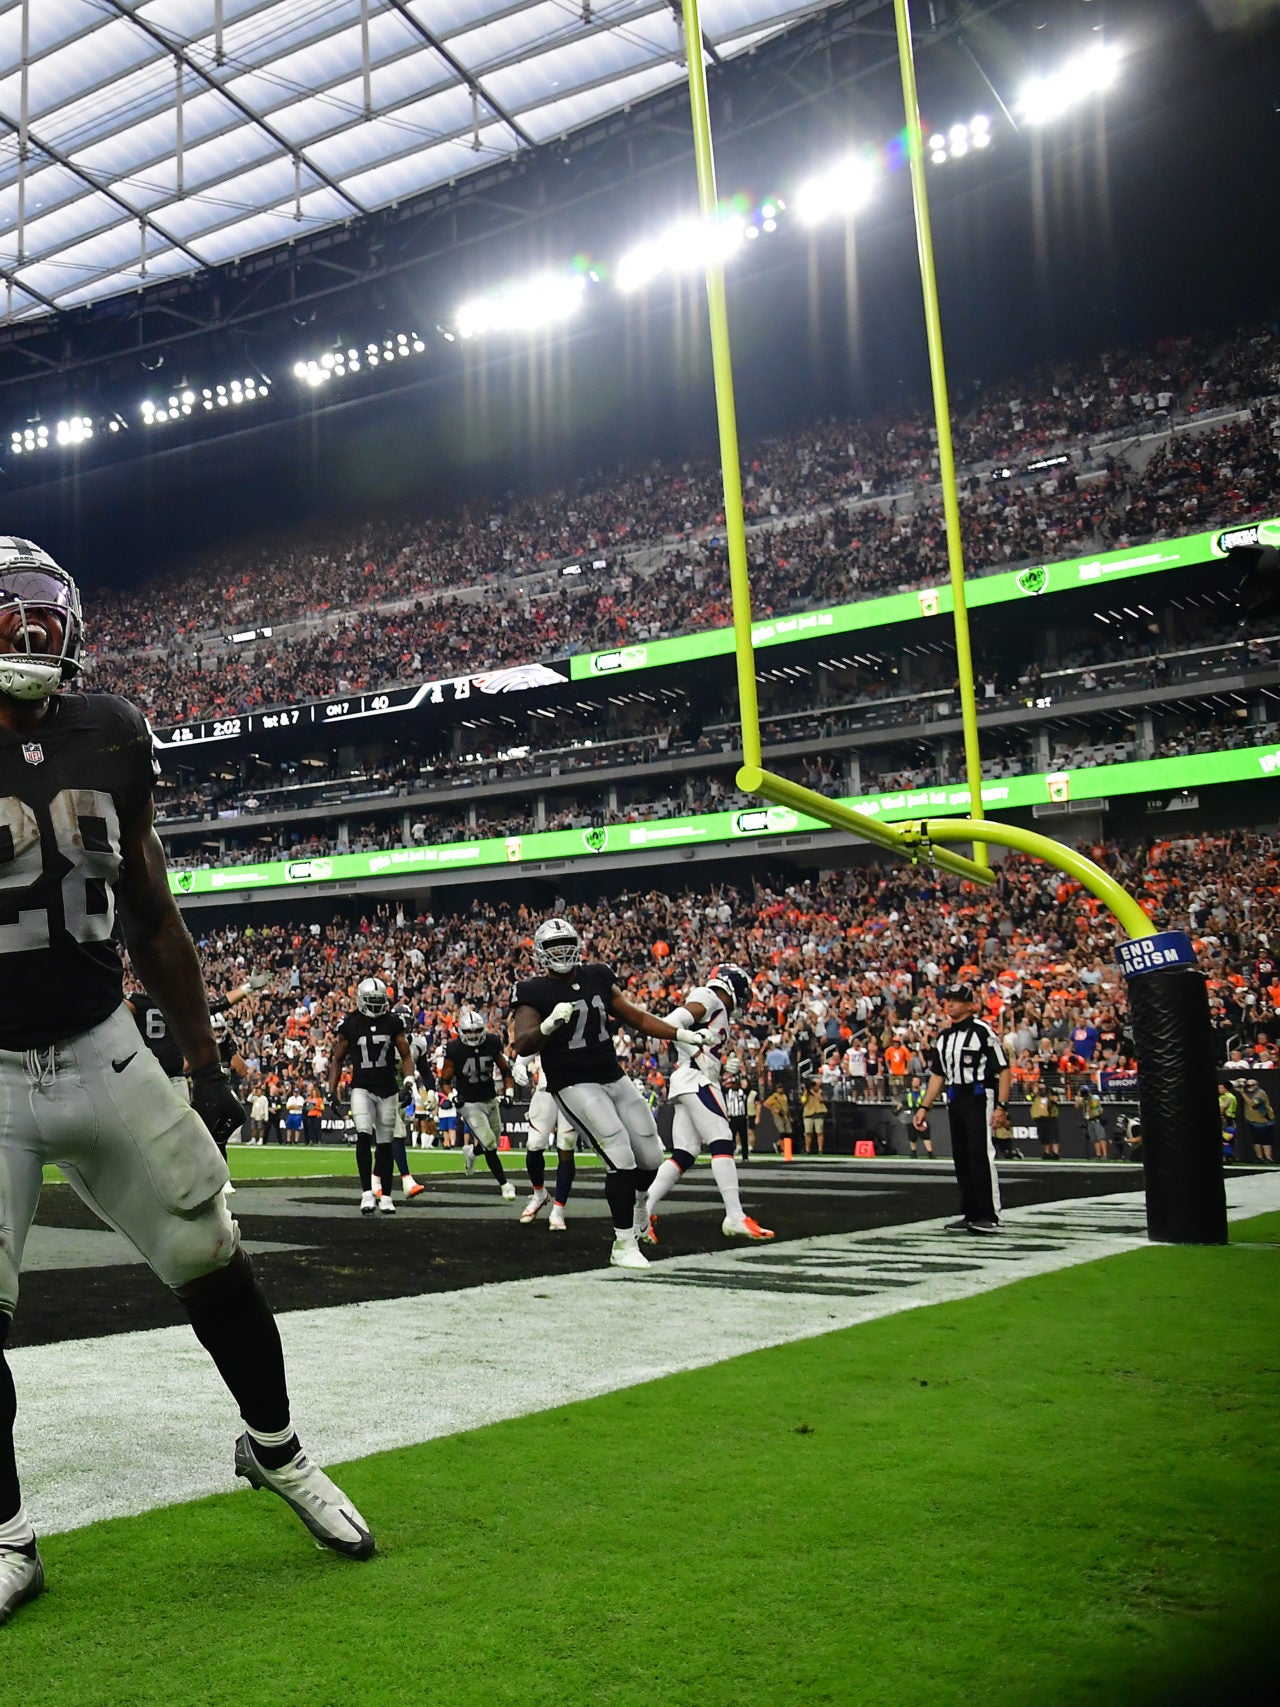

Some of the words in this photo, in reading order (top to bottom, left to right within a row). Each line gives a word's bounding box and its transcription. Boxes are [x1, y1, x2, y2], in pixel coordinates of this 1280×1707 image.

[342, 702, 349, 714] 7
[371, 696, 389, 710] 40
[213, 719, 241, 736] 2:02
[262, 715, 278, 728] 1st
[280, 713, 289, 725] &
[291, 711, 299, 724] 7
[1120, 940, 1155, 961] END
[568, 994, 610, 1050] 71
[356, 1034, 391, 1069] 17
[461, 1055, 494, 1084] 45
[1108, 1078, 1138, 1087] BRON
